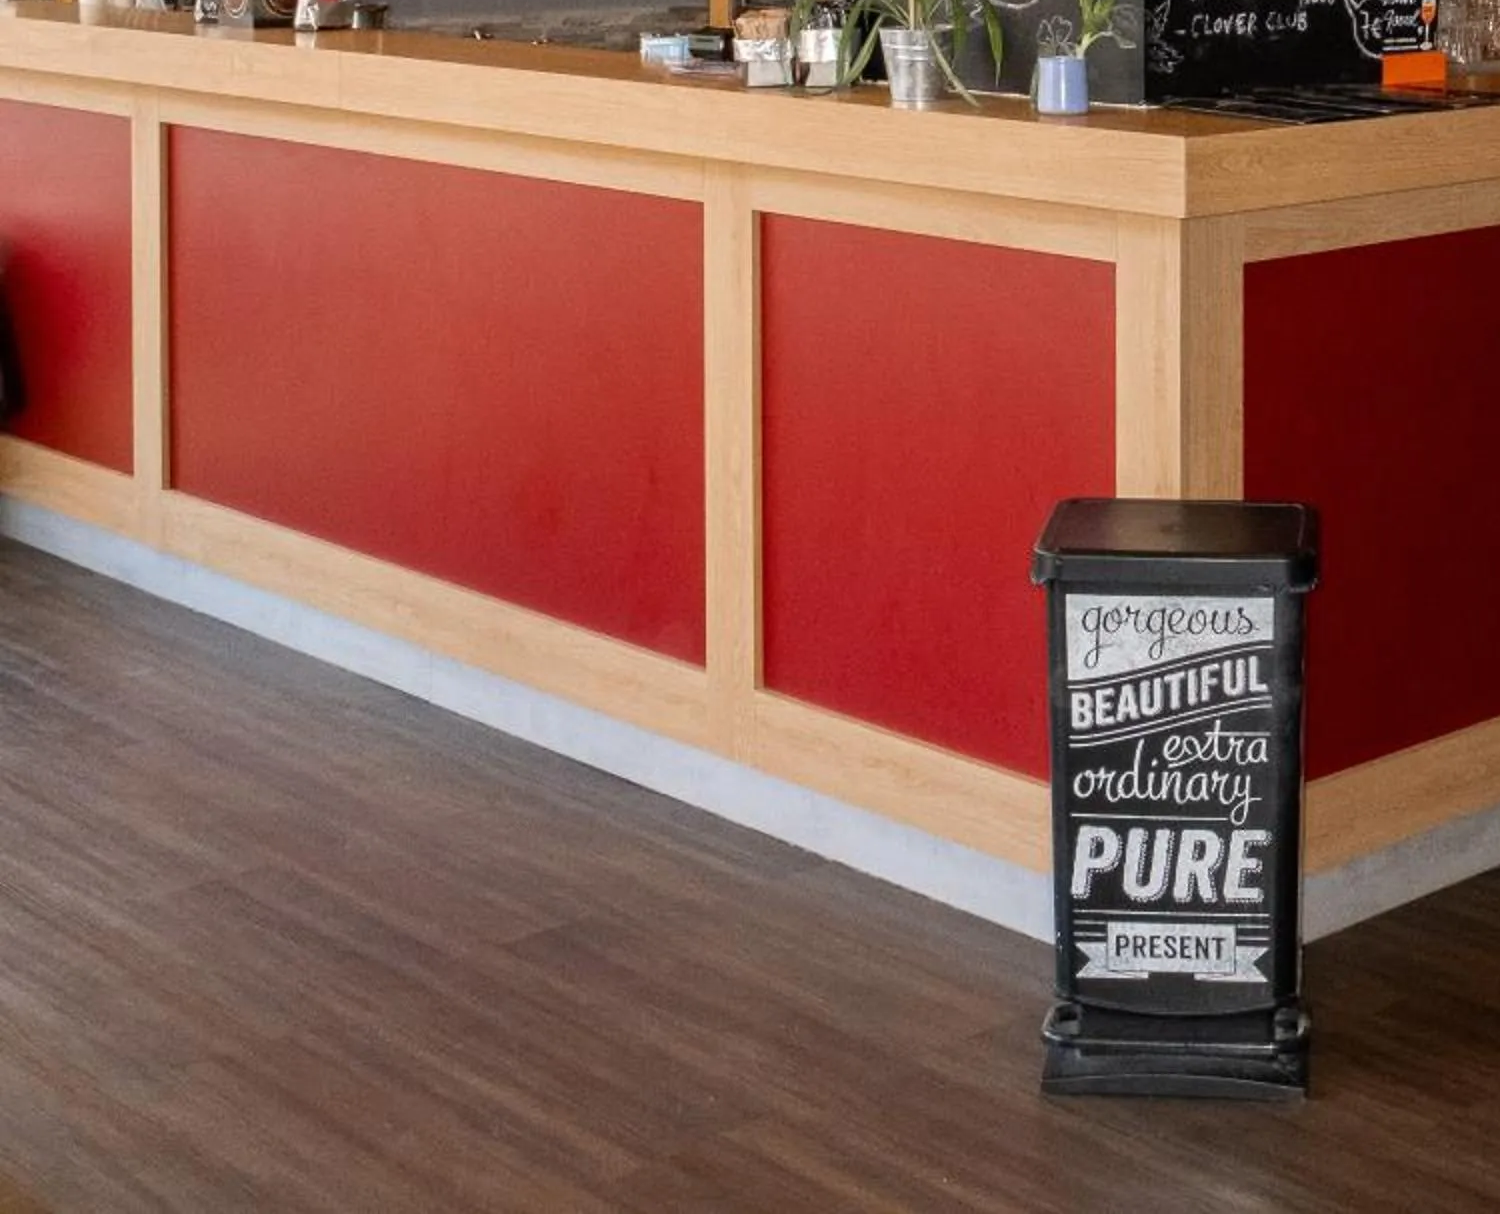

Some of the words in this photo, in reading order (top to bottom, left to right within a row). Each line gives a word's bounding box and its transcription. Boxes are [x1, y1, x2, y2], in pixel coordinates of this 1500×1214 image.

[1191, 12, 1257, 38] CLOVER
[1265, 10, 1308, 32] CLUB
[1082, 605, 1259, 668] gorgeous
[1070, 655, 1269, 731] BEAUTIFUL
[1163, 719, 1271, 768] extra
[1073, 738, 1262, 826] ordinary
[1070, 825, 1272, 904] PURE
[1115, 934, 1226, 960] PRESENT
